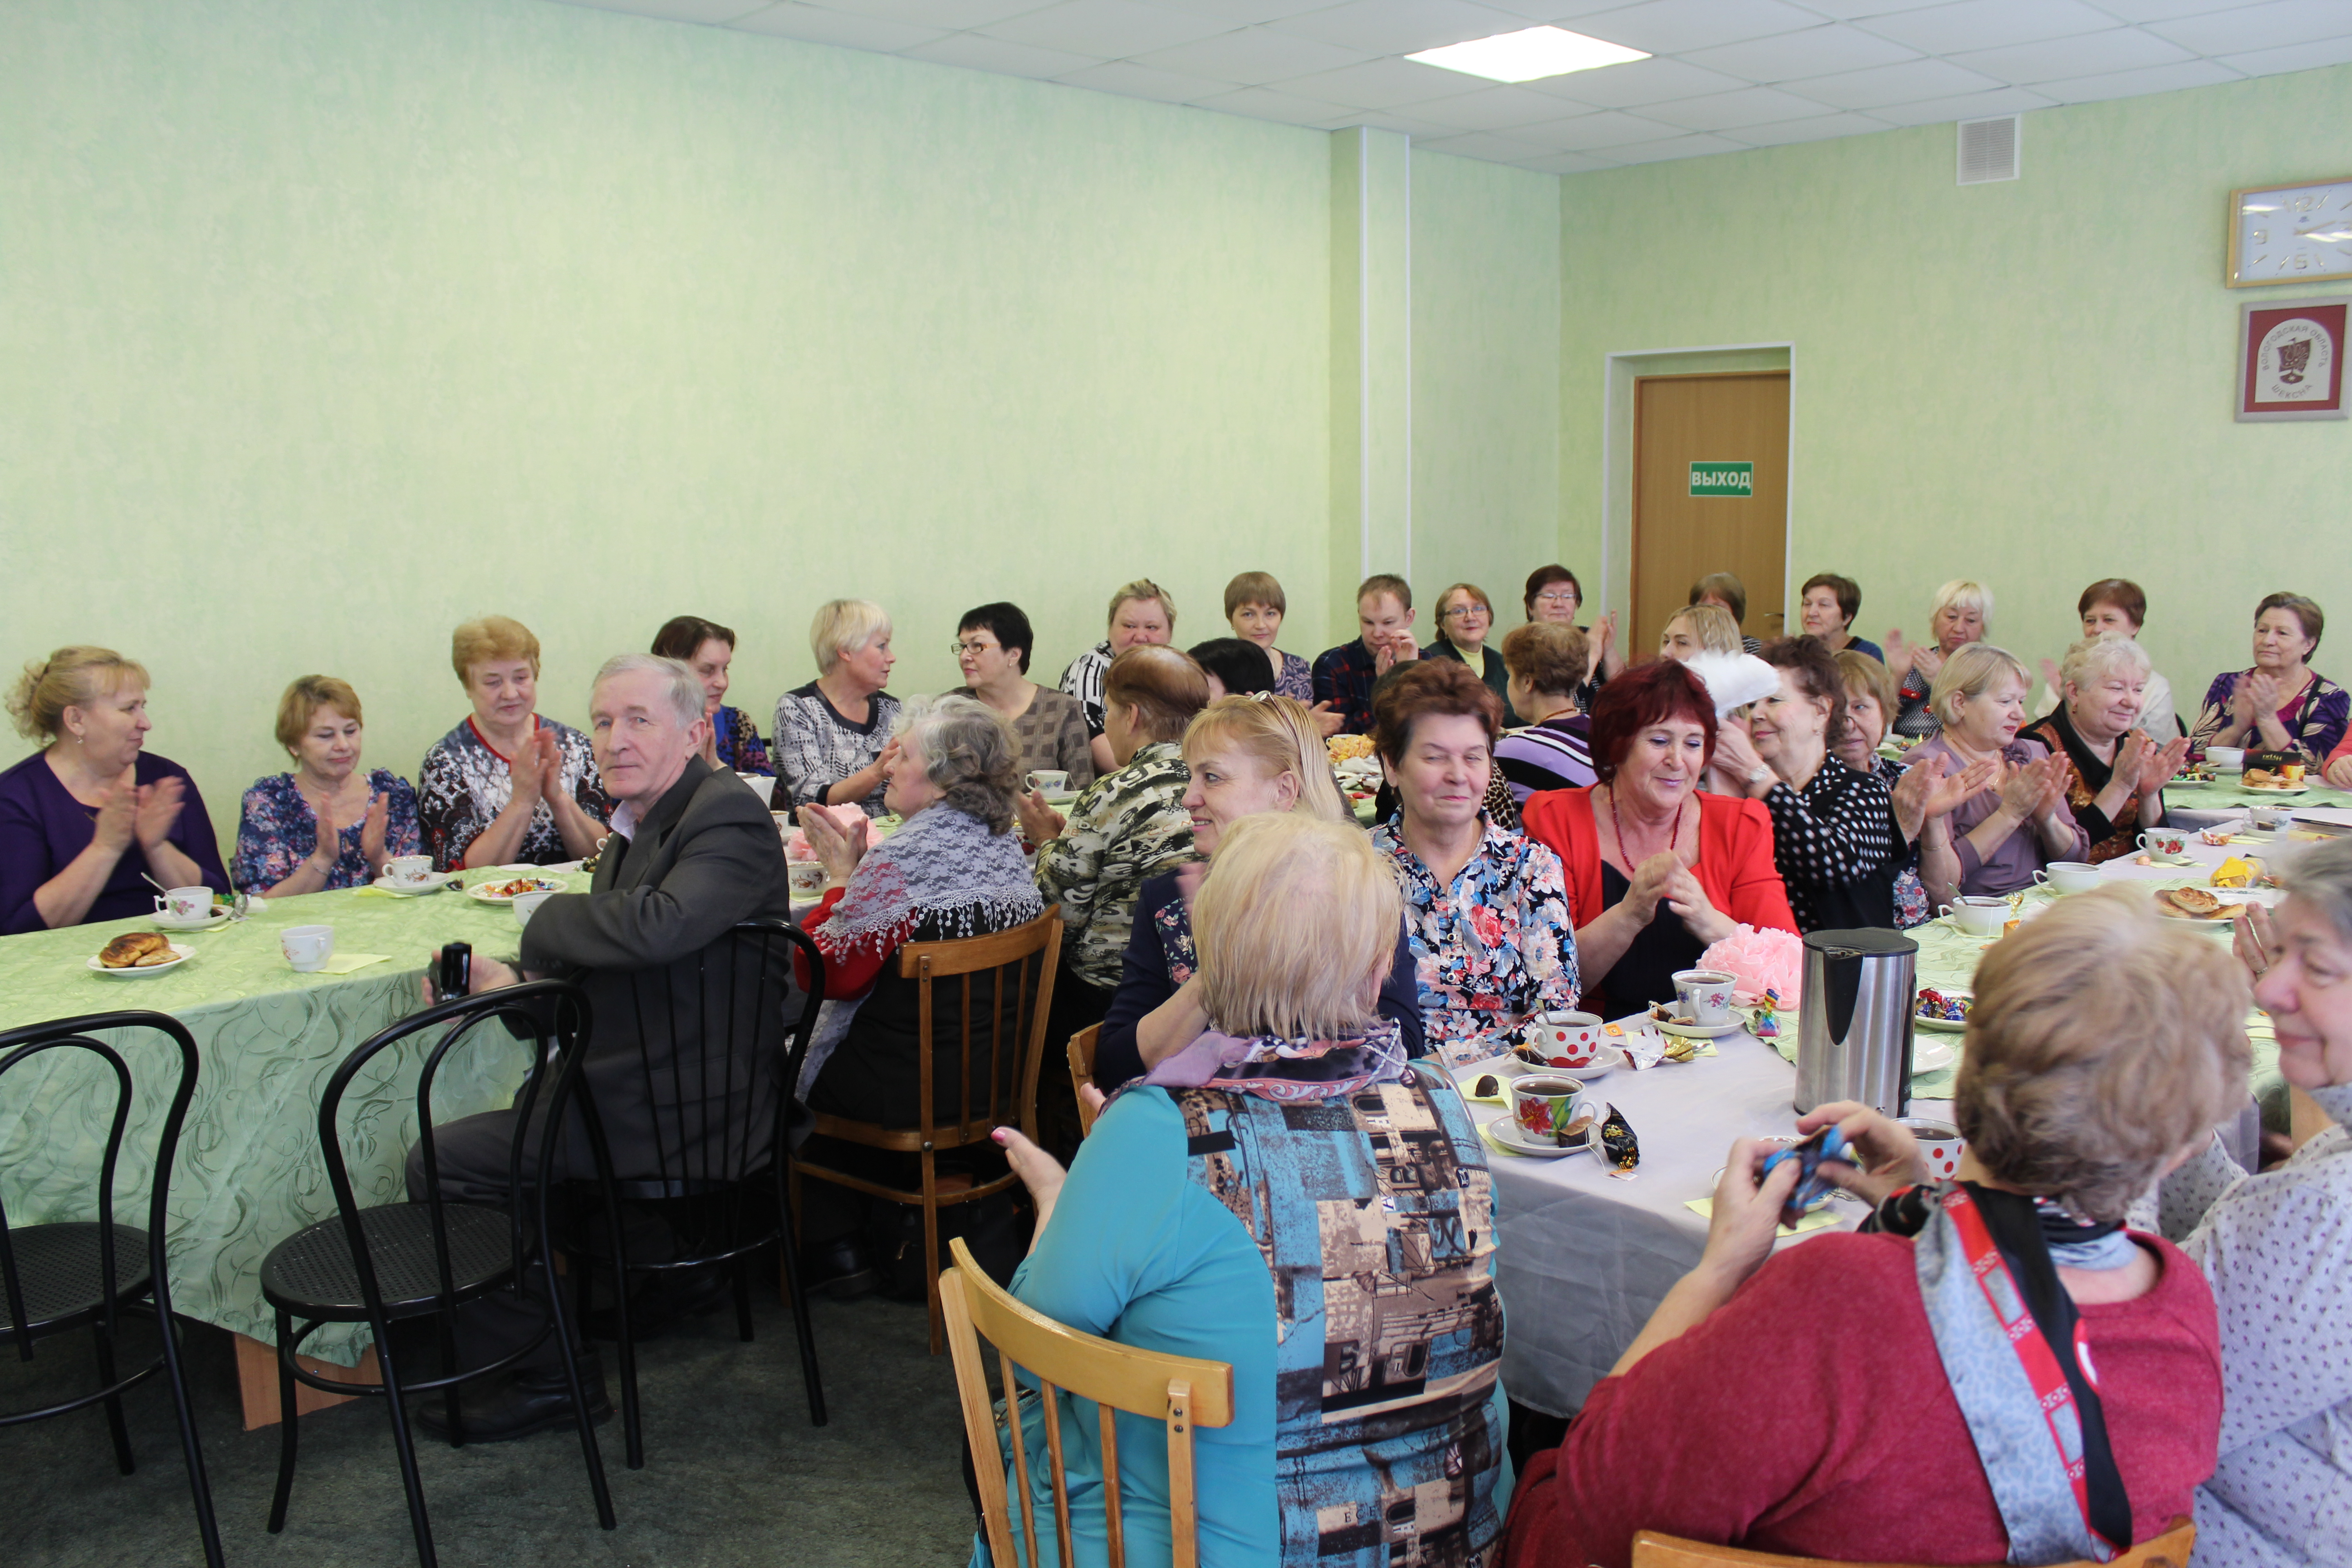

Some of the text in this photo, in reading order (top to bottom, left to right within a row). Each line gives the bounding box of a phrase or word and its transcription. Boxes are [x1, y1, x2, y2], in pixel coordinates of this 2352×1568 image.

[2261, 325, 2329, 371] ВОЛОГОДСКАЯ ОБЛАСТЬ
[2271, 384, 2313, 399] ШЕКСНА
[1691, 471, 1752, 489] ВЫХОД
